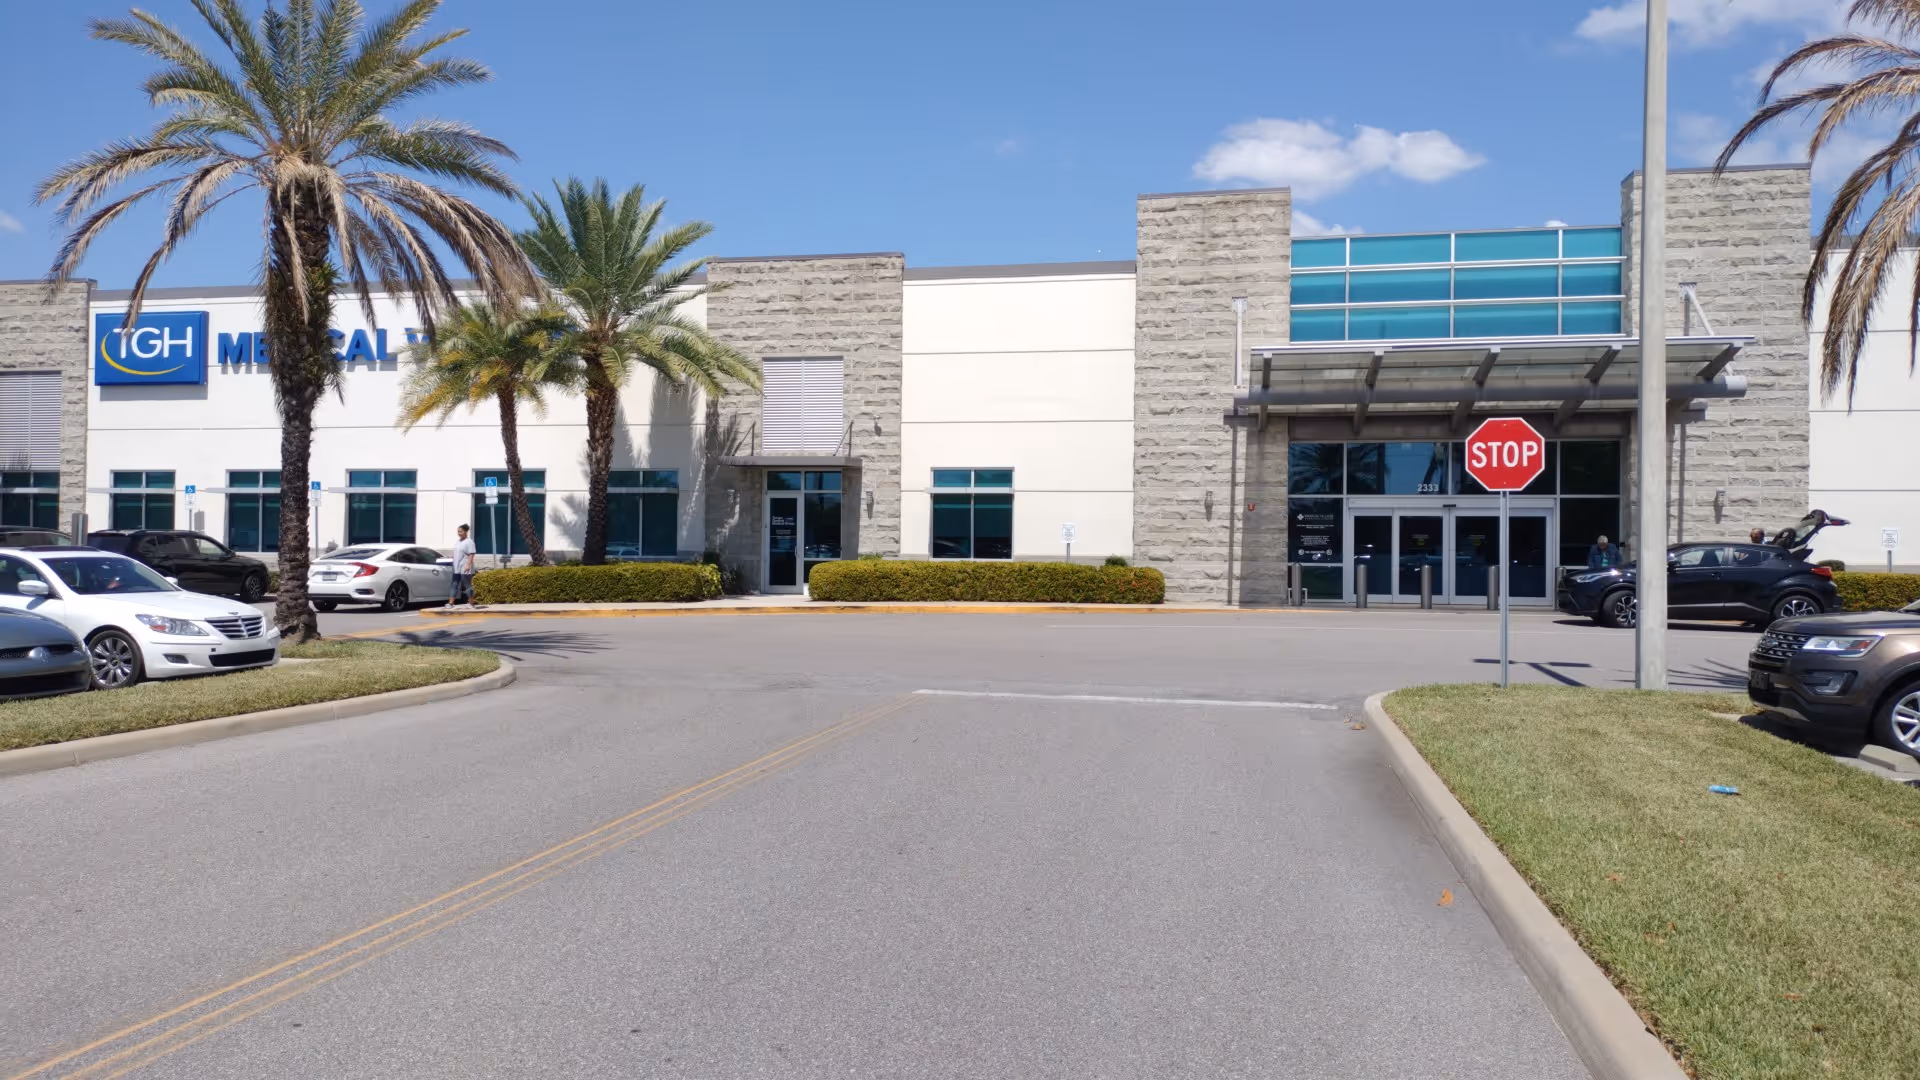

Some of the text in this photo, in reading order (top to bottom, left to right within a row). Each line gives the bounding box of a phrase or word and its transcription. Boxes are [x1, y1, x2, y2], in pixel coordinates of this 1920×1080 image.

[113, 326, 193, 359] TGH
[218, 328, 398, 364] MECAL
[1471, 440, 1539, 468] STOP
[1417, 483, 1439, 492] 2333
